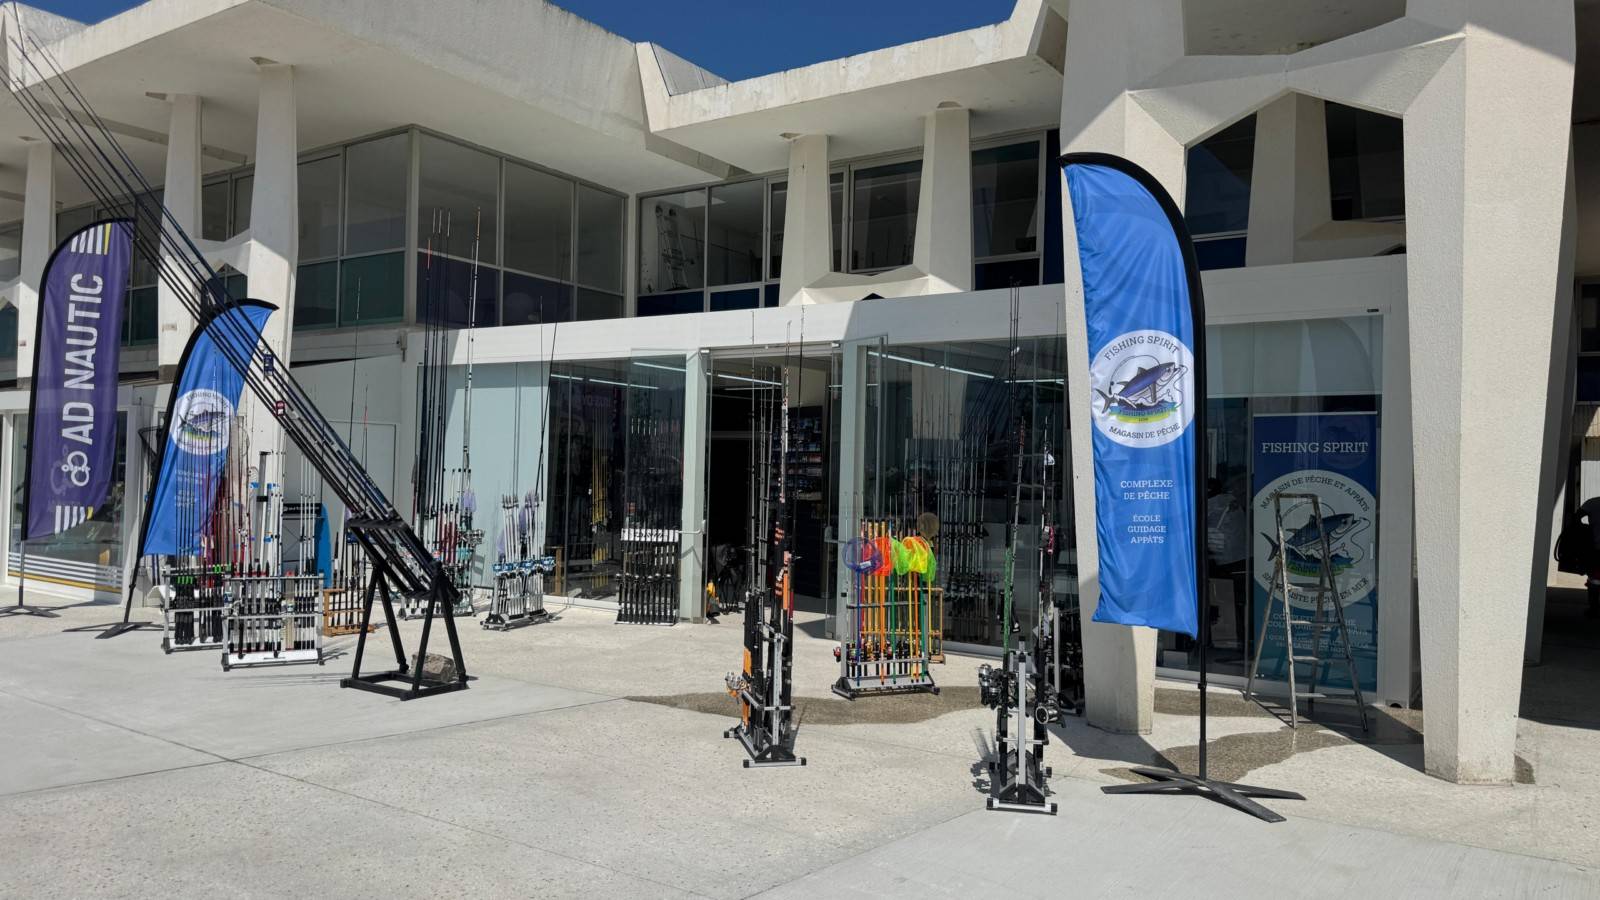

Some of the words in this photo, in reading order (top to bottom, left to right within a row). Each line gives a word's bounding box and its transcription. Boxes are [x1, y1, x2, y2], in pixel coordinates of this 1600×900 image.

[64, 273, 103, 390] NAUTIC
[1104, 335, 1144, 360] FISHING
[1147, 335, 1180, 354] SPIRIT
[62, 401, 94, 445] AD
[1109, 426, 1144, 439] MAGASIN
[1156, 422, 1181, 437] PÊCHE
[1262, 442, 1319, 453] FISHING
[1323, 441, 1368, 453] SPIRIT
[1120, 480, 1174, 488] COMPLEXE
[1123, 492, 1136, 500] DE
[1137, 490, 1170, 500] PÊCHE
[1260, 481, 1291, 509] MAGASIN
[1292, 477, 1303, 486] DE
[1304, 475, 1332, 486] PÊCHE
[1334, 480, 1346, 490] ET
[1345, 487, 1370, 512] APPÂTS
[1132, 513, 1161, 522] ÉCOLE
[1127, 525, 1167, 533] GUIDAGE
[1130, 535, 1165, 544] APPÂTS
